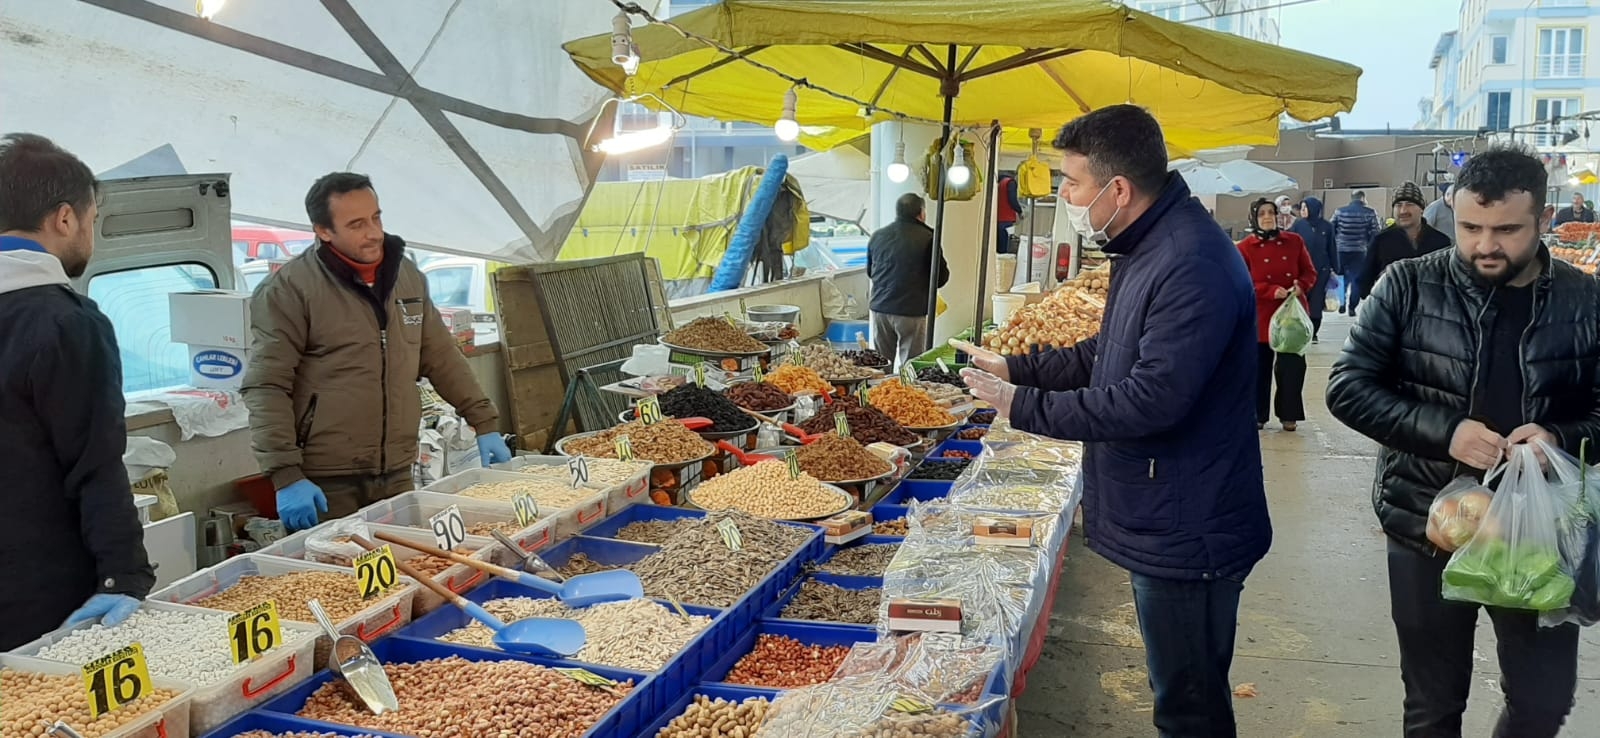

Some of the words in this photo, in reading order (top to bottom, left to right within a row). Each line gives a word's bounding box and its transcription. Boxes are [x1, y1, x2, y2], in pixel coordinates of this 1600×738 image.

[641, 401, 660, 425] 60
[569, 458, 588, 489] 50
[434, 513, 464, 550] 90
[358, 555, 395, 602] 20
[233, 613, 274, 663] 16
[90, 658, 142, 716] 16
